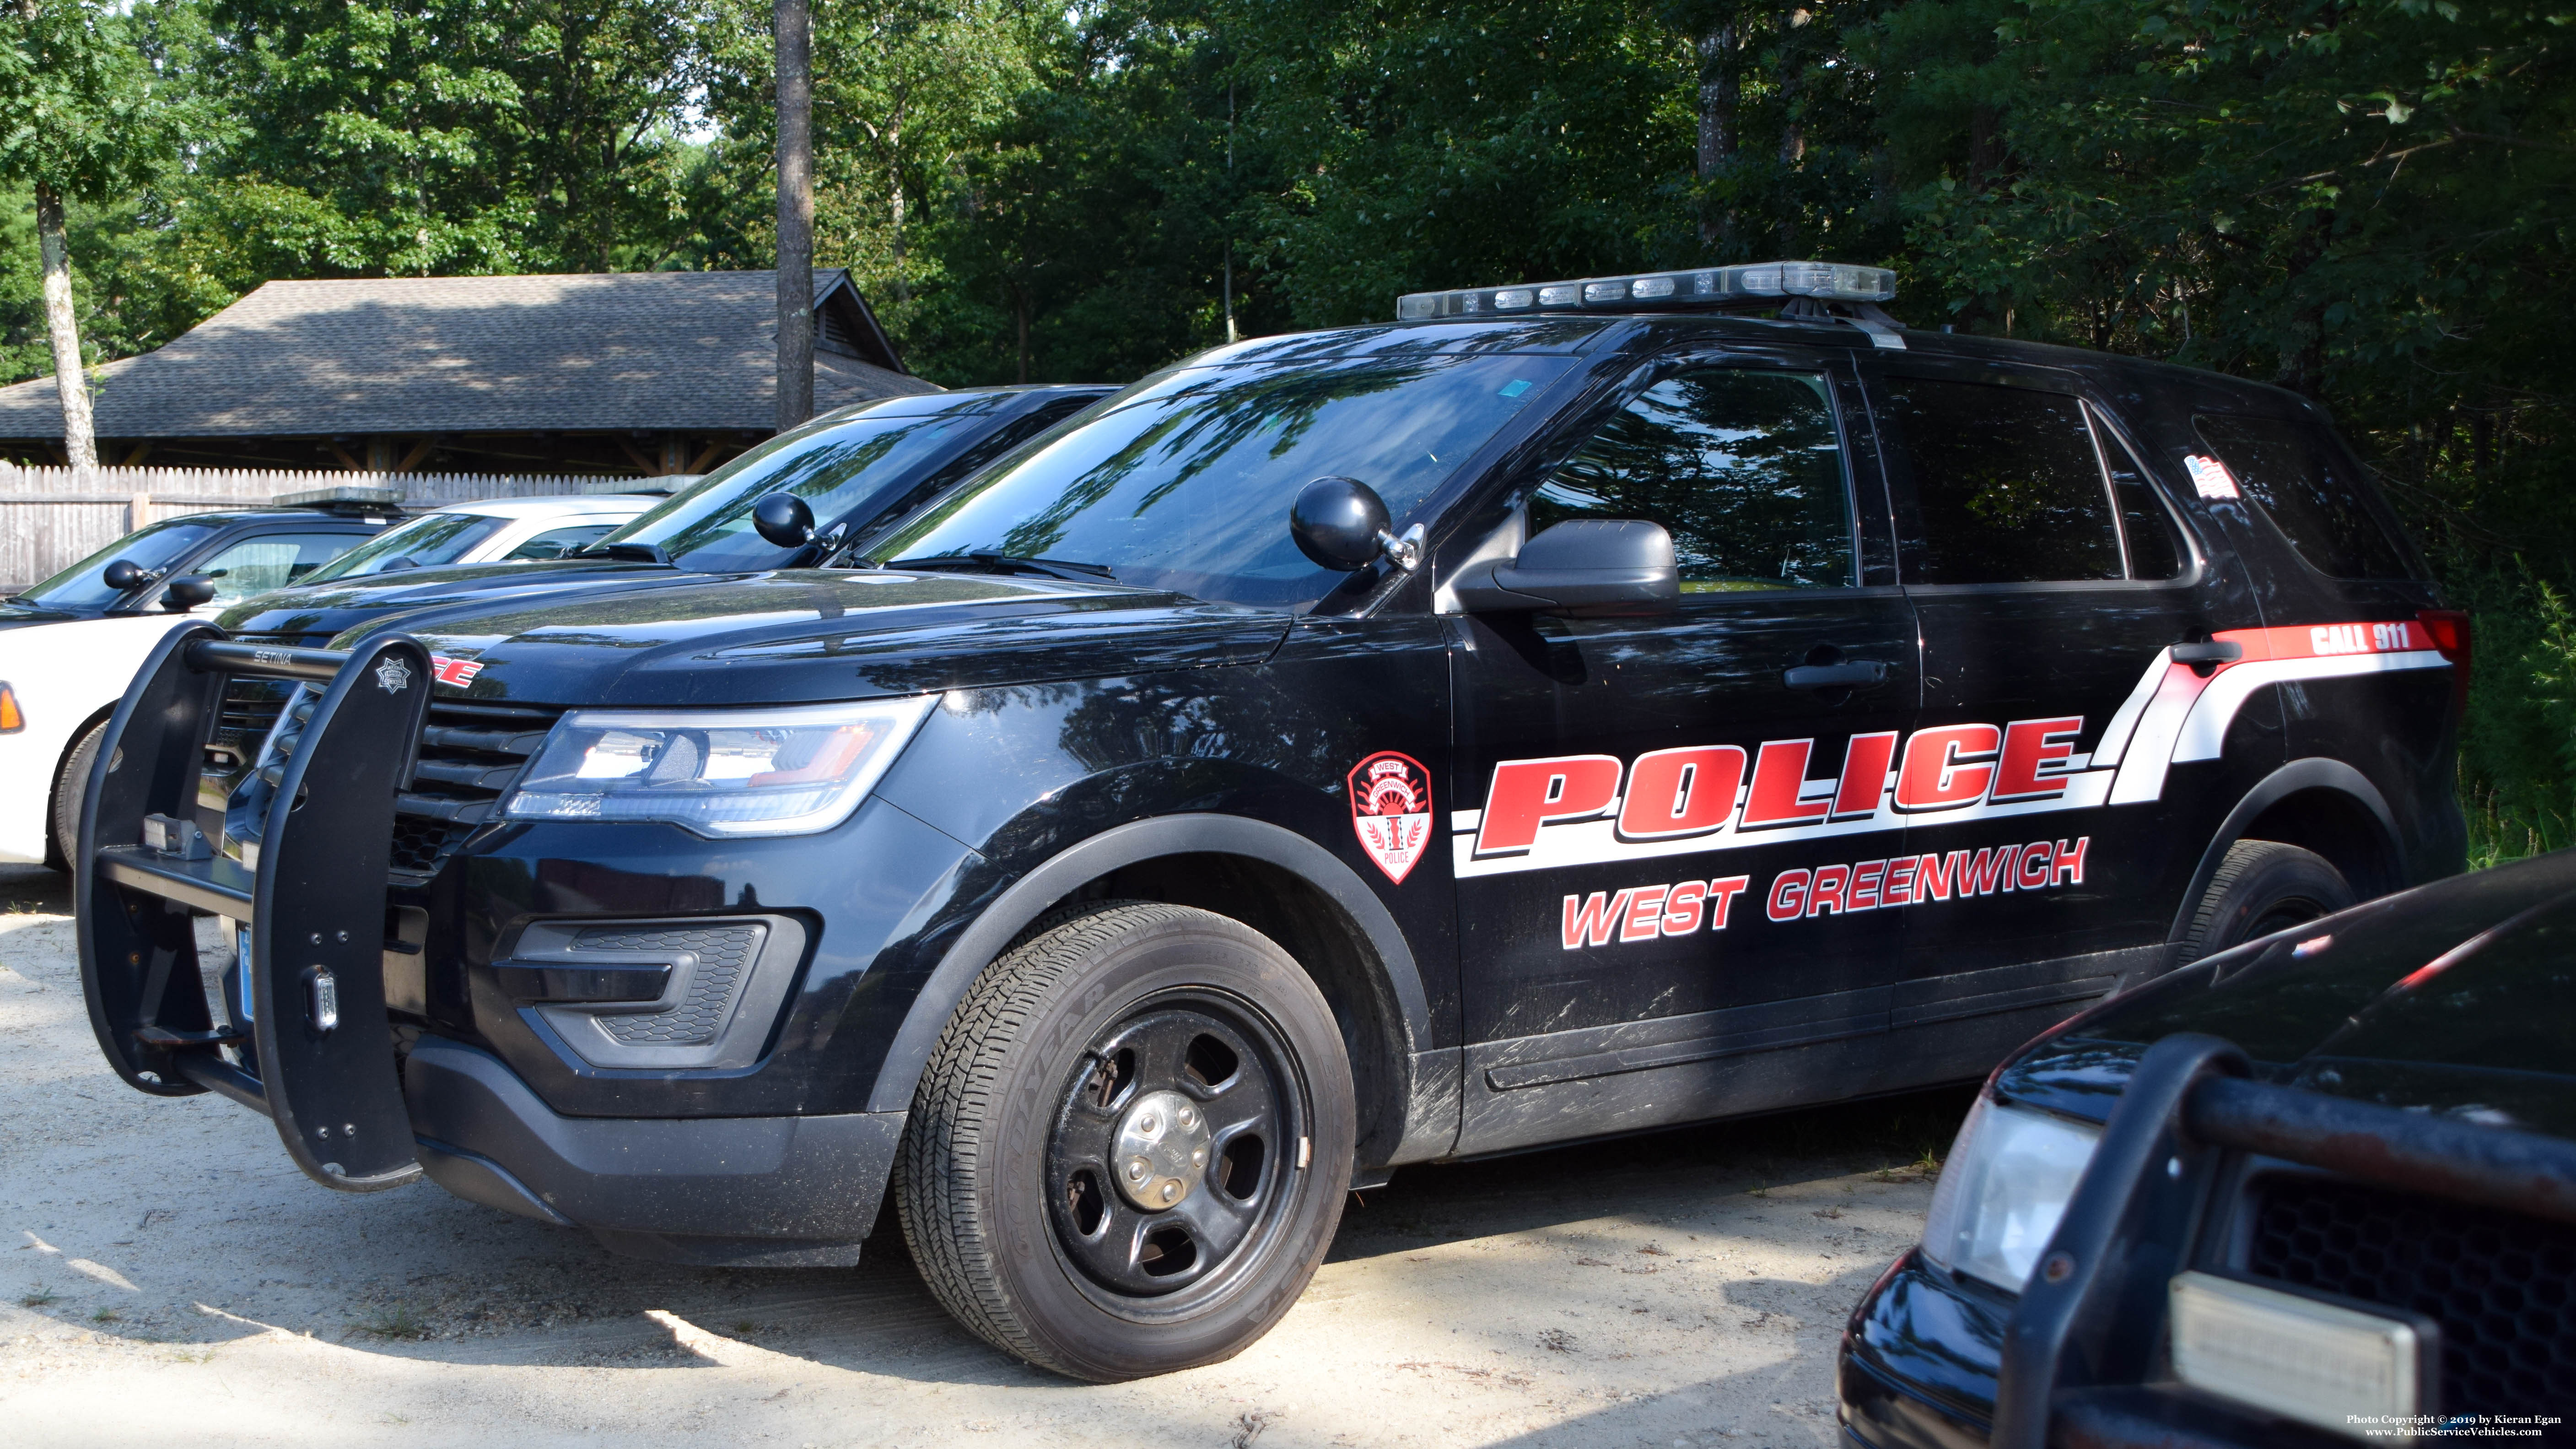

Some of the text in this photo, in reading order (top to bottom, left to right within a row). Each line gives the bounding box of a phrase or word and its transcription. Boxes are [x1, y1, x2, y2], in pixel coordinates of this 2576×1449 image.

[2311, 623, 2408, 654] CALL 911
[254, 651, 291, 665] SETINA
[1377, 762, 1399, 771] WEST
[1373, 781, 1410, 798] GREENWICH
[1471, 715, 2084, 859] POLICE
[1385, 852, 1409, 864] POLICE
[1562, 837, 2090, 950] WEST GREENWICH
[1006, 982, 1106, 1258] GOODYEAR
